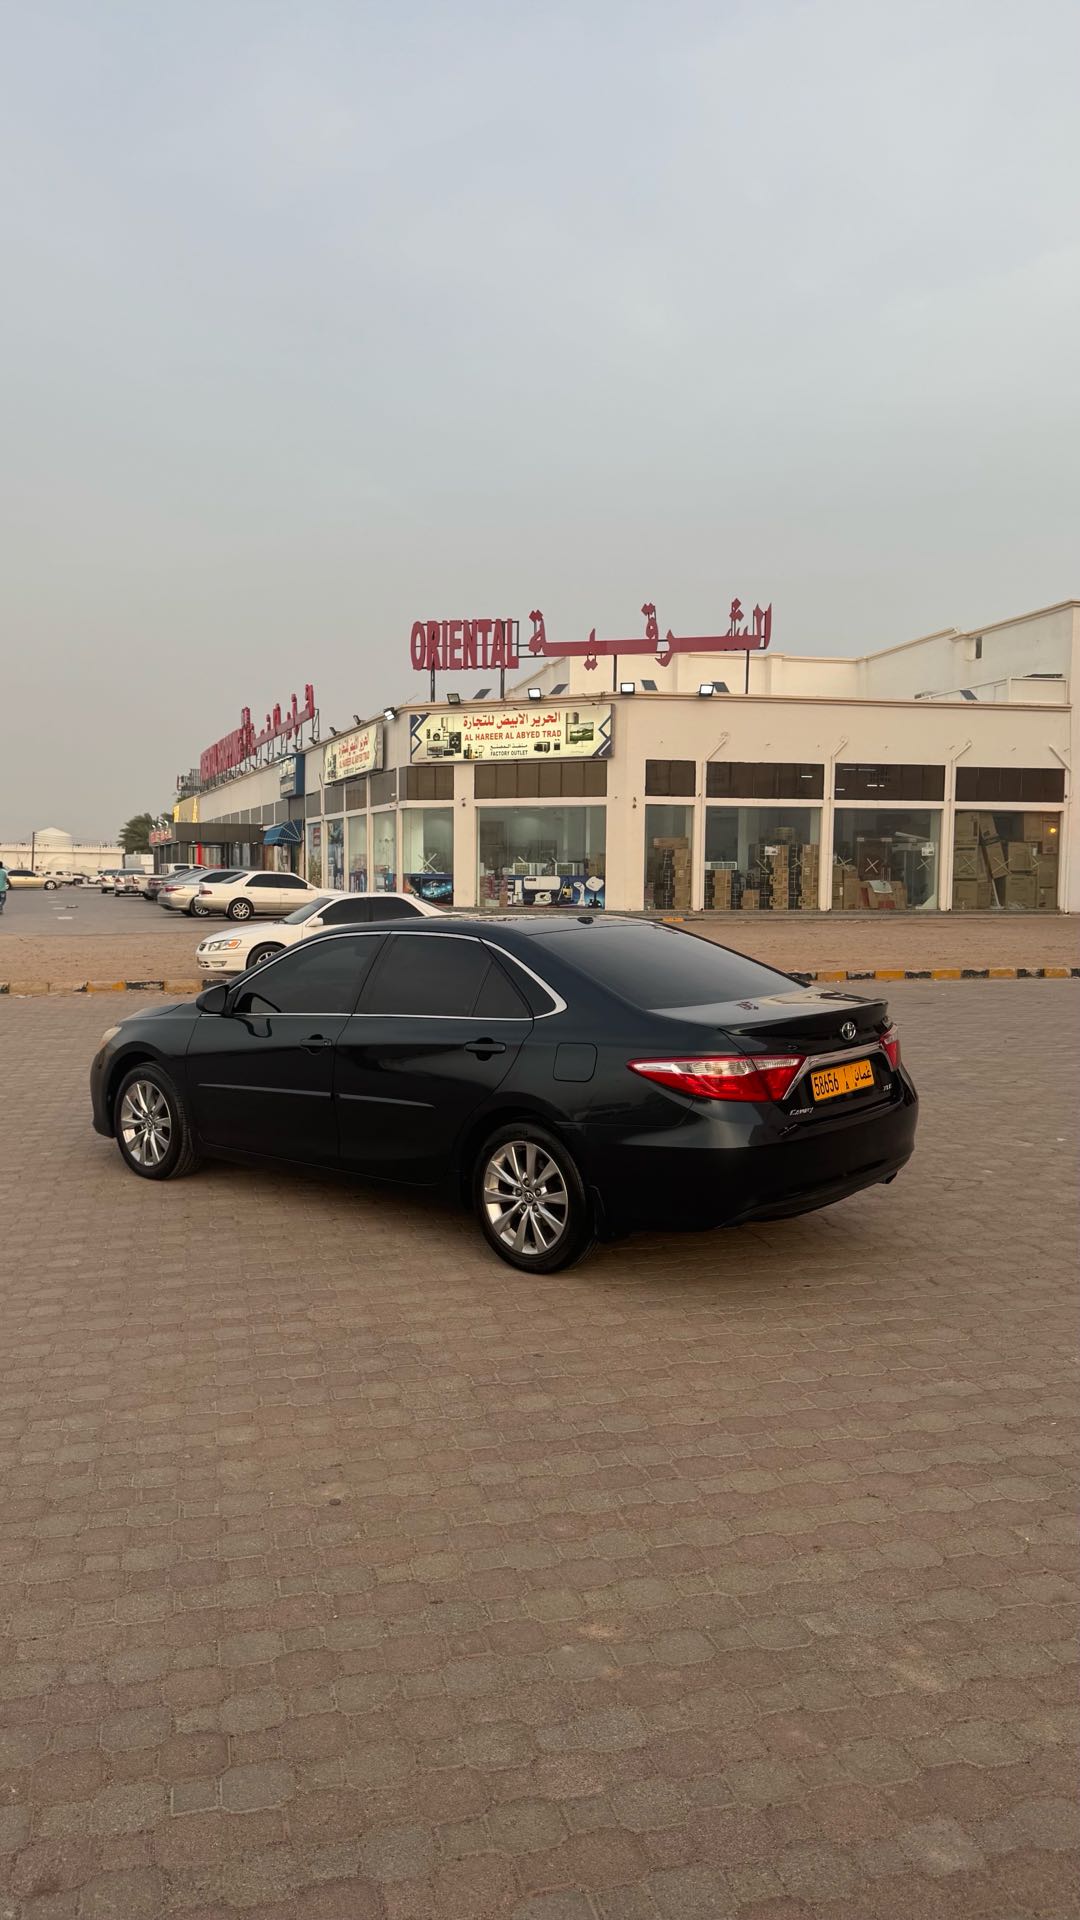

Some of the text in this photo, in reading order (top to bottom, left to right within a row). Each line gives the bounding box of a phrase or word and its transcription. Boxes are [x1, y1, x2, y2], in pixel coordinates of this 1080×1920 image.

[411, 618, 519, 671] ORIENTAL
[463, 711, 561, 729] الحرير الابيض للتجارة
[464, 729, 561, 741] AL HAREER AL ABYED TRAD
[813, 1071, 840, 1096] 58656
